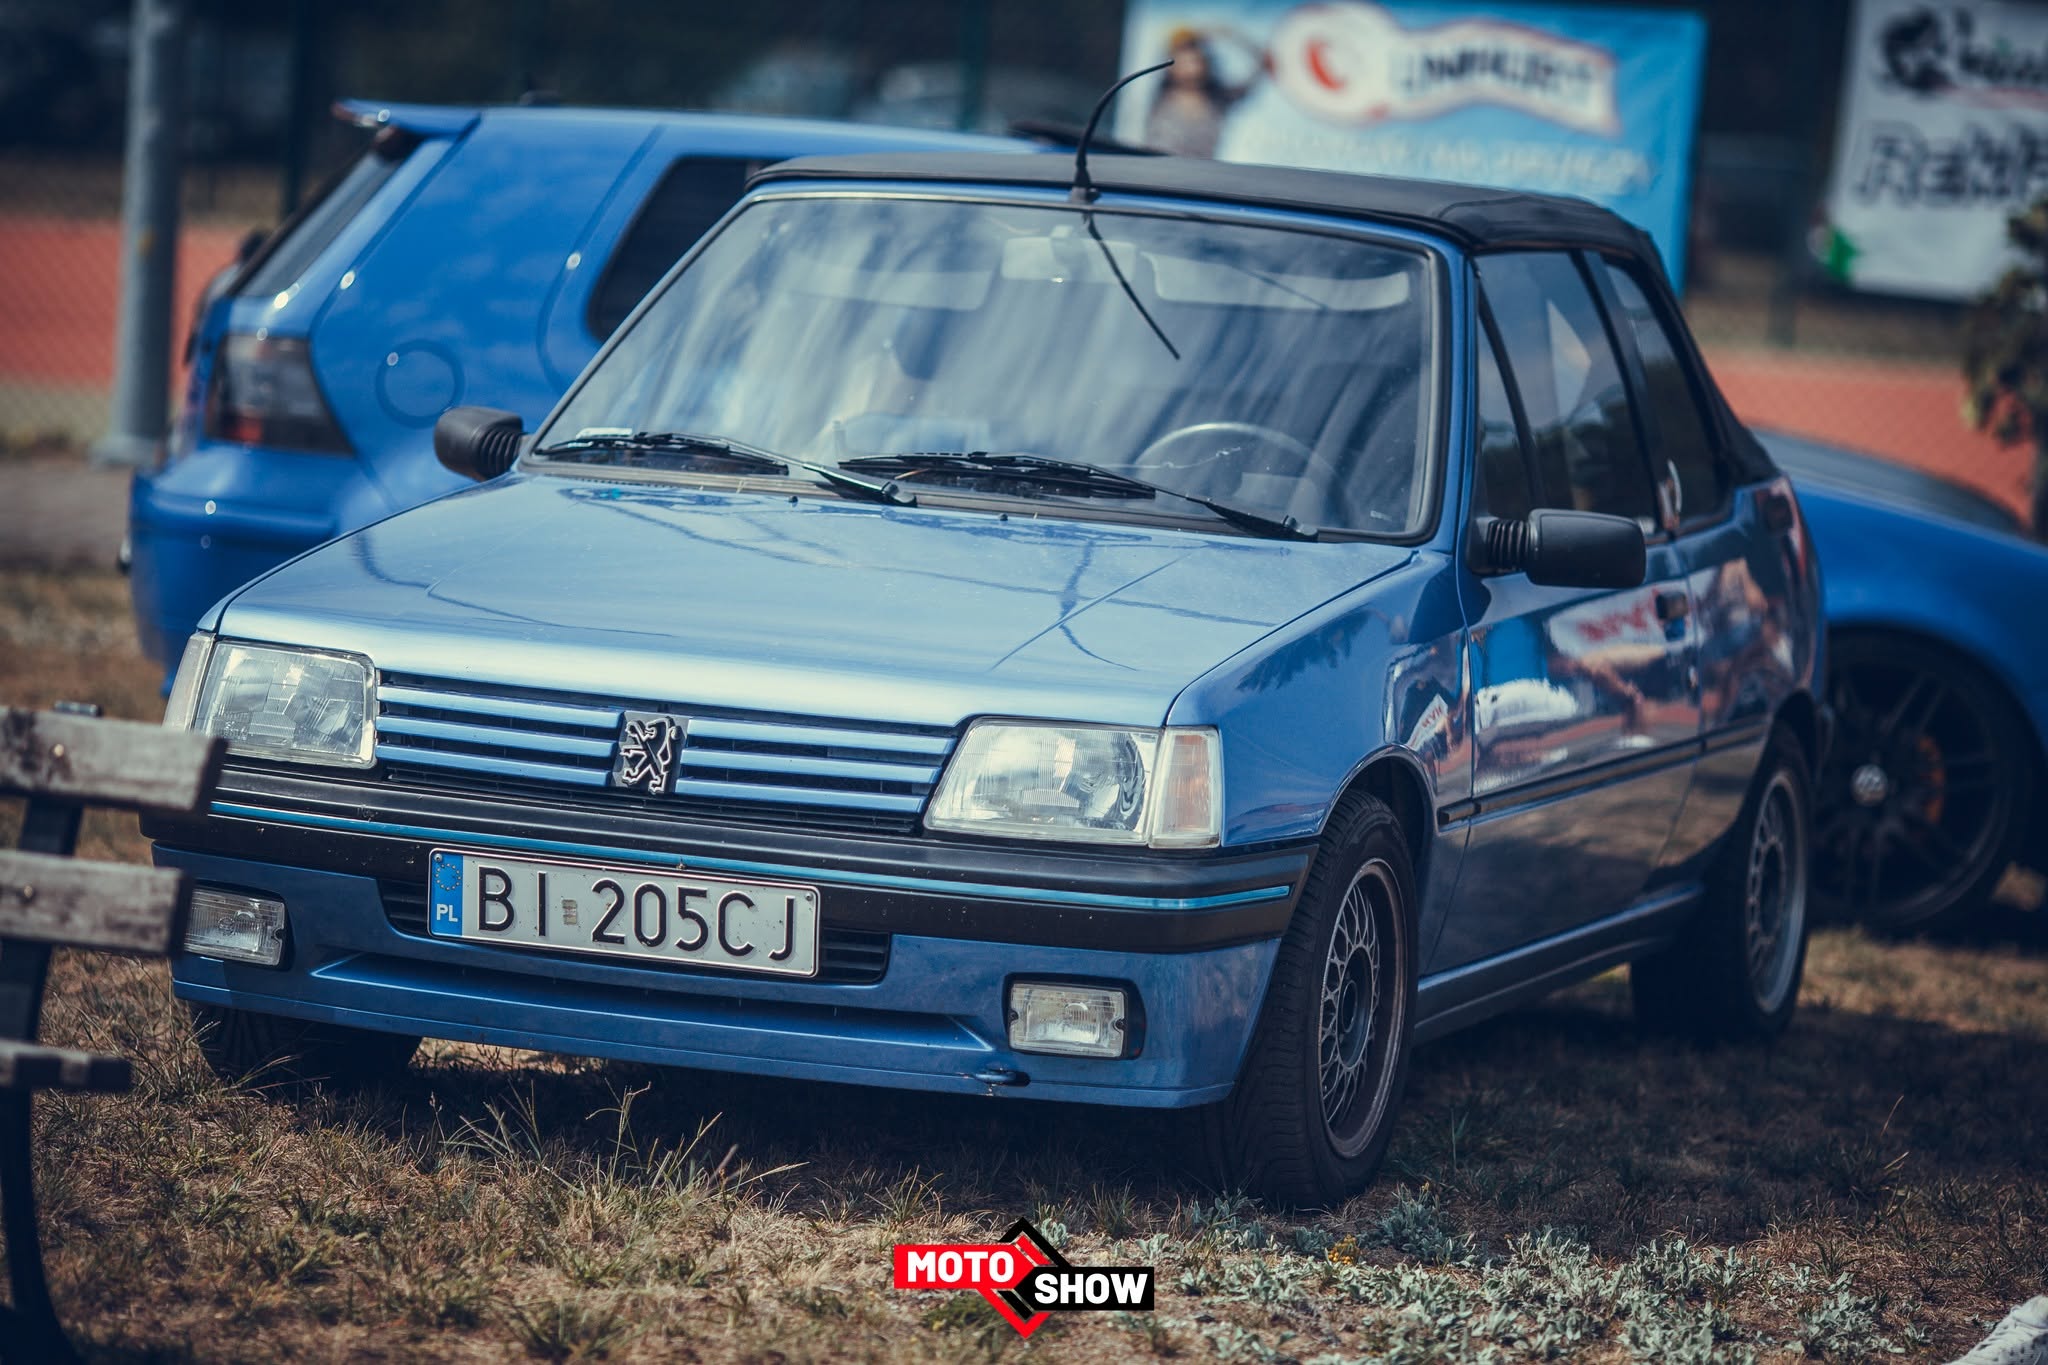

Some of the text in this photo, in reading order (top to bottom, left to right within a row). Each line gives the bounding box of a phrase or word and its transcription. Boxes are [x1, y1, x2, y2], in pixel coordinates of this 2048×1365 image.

[436, 903, 458, 923] PL
[477, 865, 796, 961] BI 205CJ
